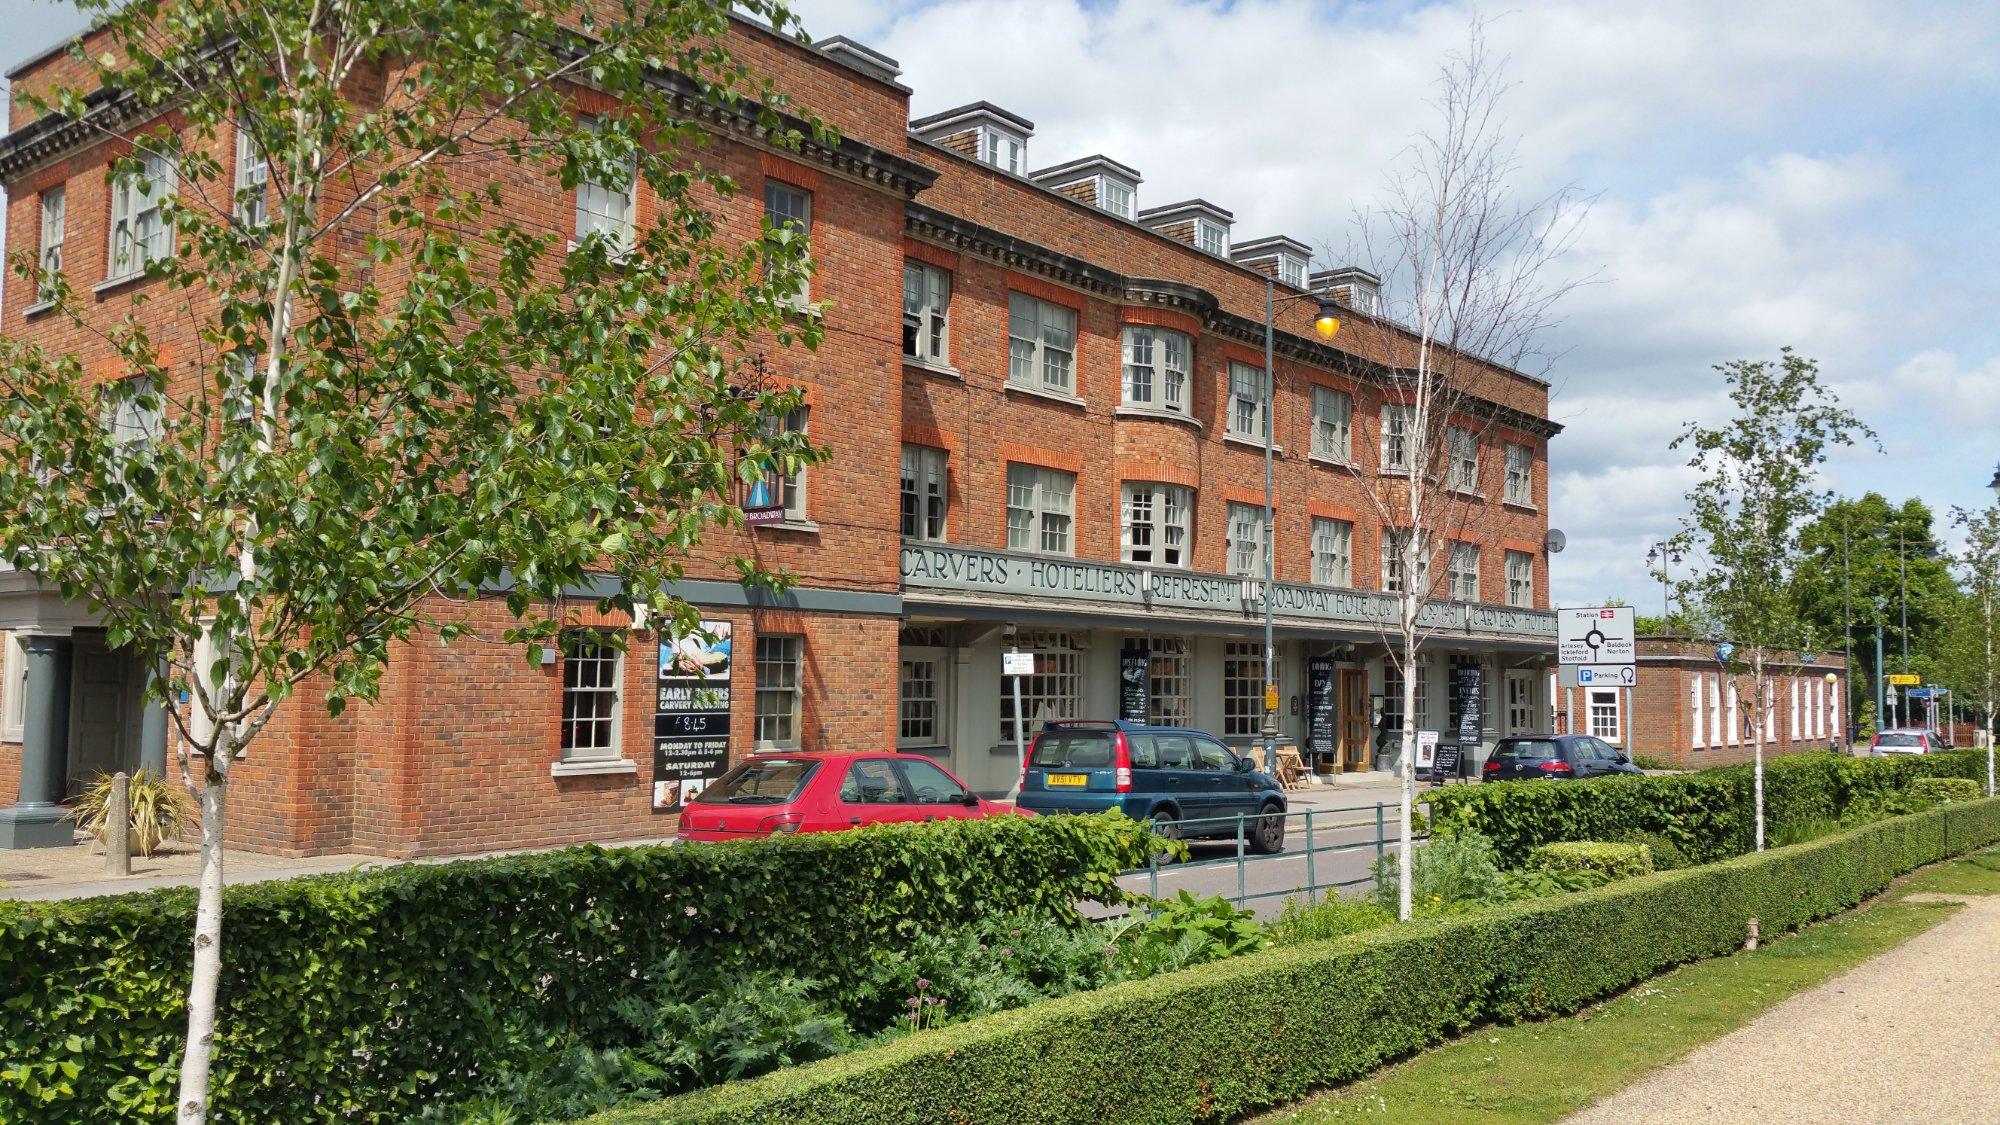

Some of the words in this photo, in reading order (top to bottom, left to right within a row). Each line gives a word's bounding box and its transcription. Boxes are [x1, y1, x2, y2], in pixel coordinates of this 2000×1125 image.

[749, 510, 783, 520] BROADWAY
[899, 548, 1008, 585] CARVERS
[1030, 561, 1136, 596] HOTELIERS
[1336, 593, 1375, 617] HOTEL
[1473, 607, 1517, 629] CARVERS
[660, 688, 692, 700] EARLY
[660, 700, 692, 710] CARVERY
[660, 742, 693, 751] MONDAY
[694, 741, 704, 749] TO
[705, 741, 727, 749] FRIDAY
[666, 761, 715, 770] SATURDAY
